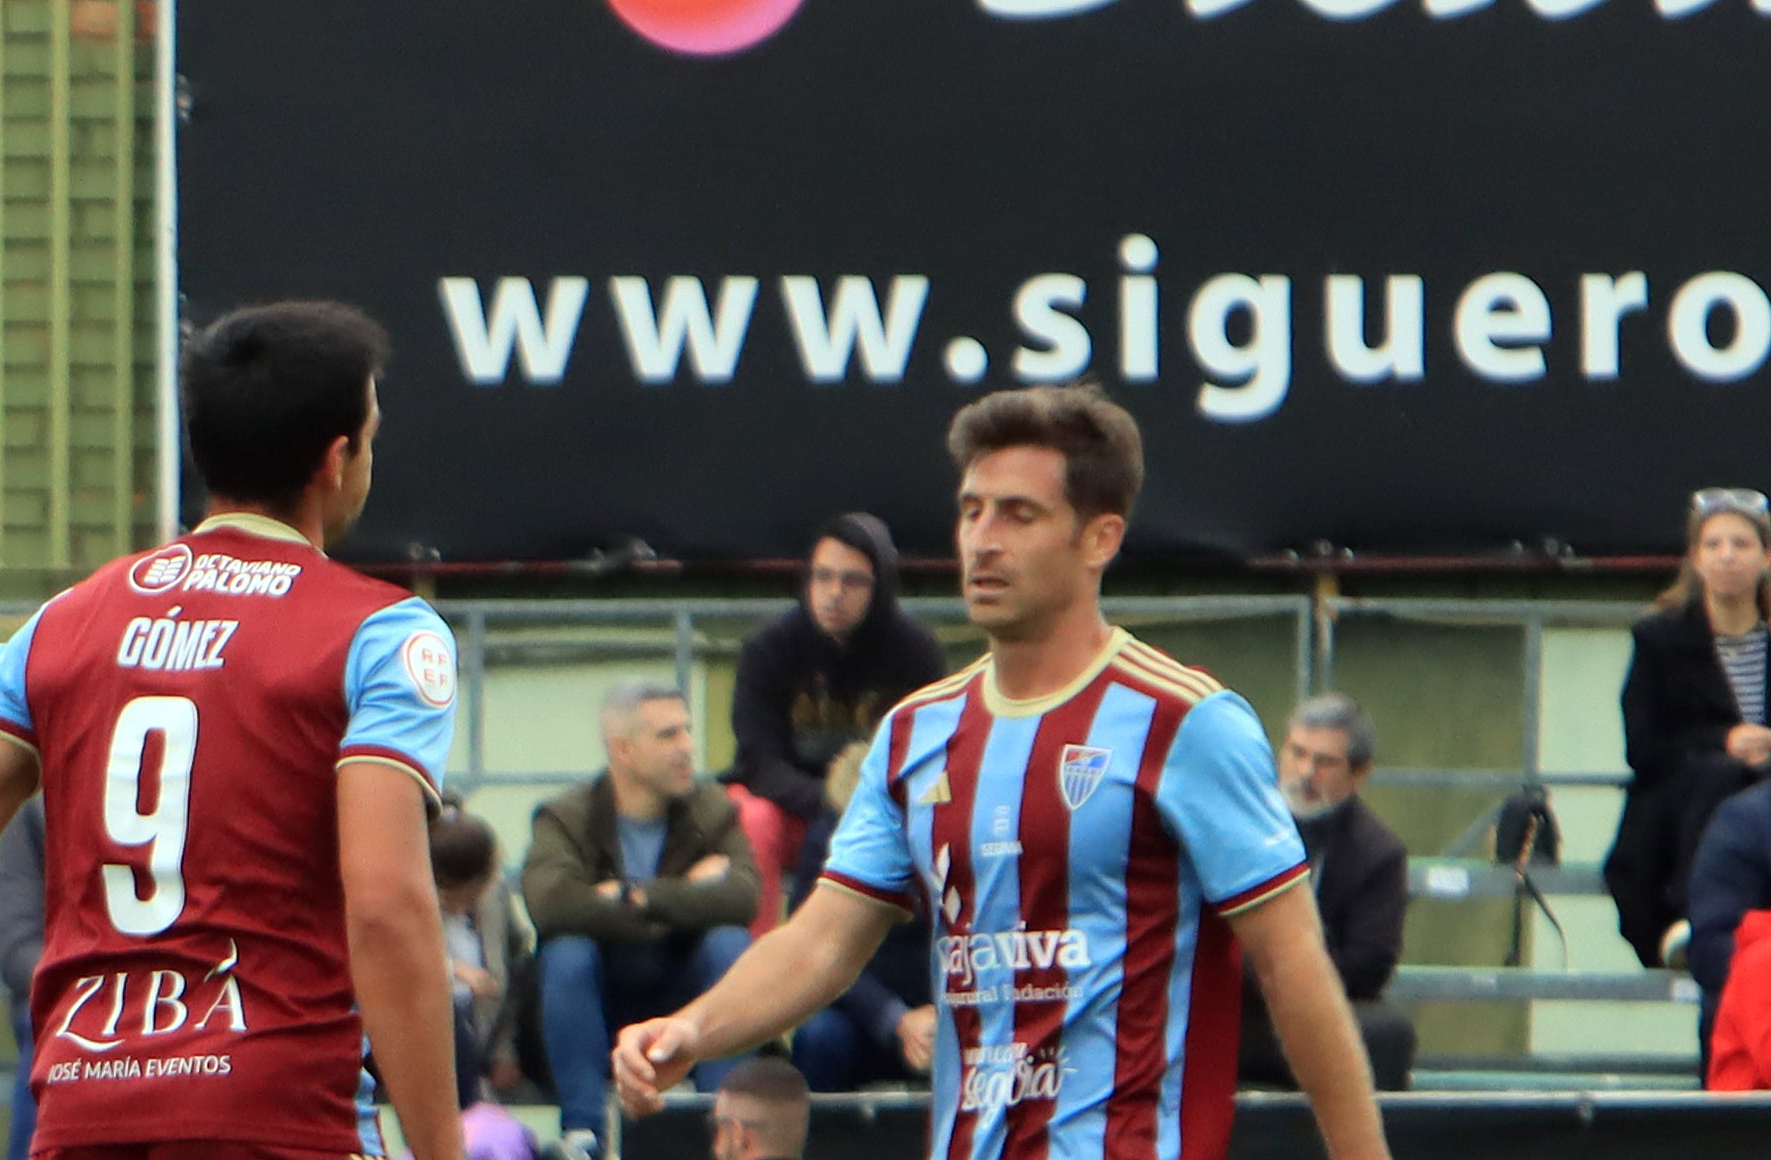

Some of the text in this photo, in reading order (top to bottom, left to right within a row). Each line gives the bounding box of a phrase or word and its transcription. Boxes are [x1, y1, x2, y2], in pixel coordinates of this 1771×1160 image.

[437, 232, 1771, 424] www.siguero
[182, 569, 295, 597] PALOMO
[194, 553, 304, 577] OCTAVIANO
[116, 605, 241, 672] GÓMEZ
[101, 695, 199, 936] 9
[55, 936, 248, 1053] ZIBÁ
[47, 1055, 233, 1085] JOSÉ MARÍA EVENTOS
